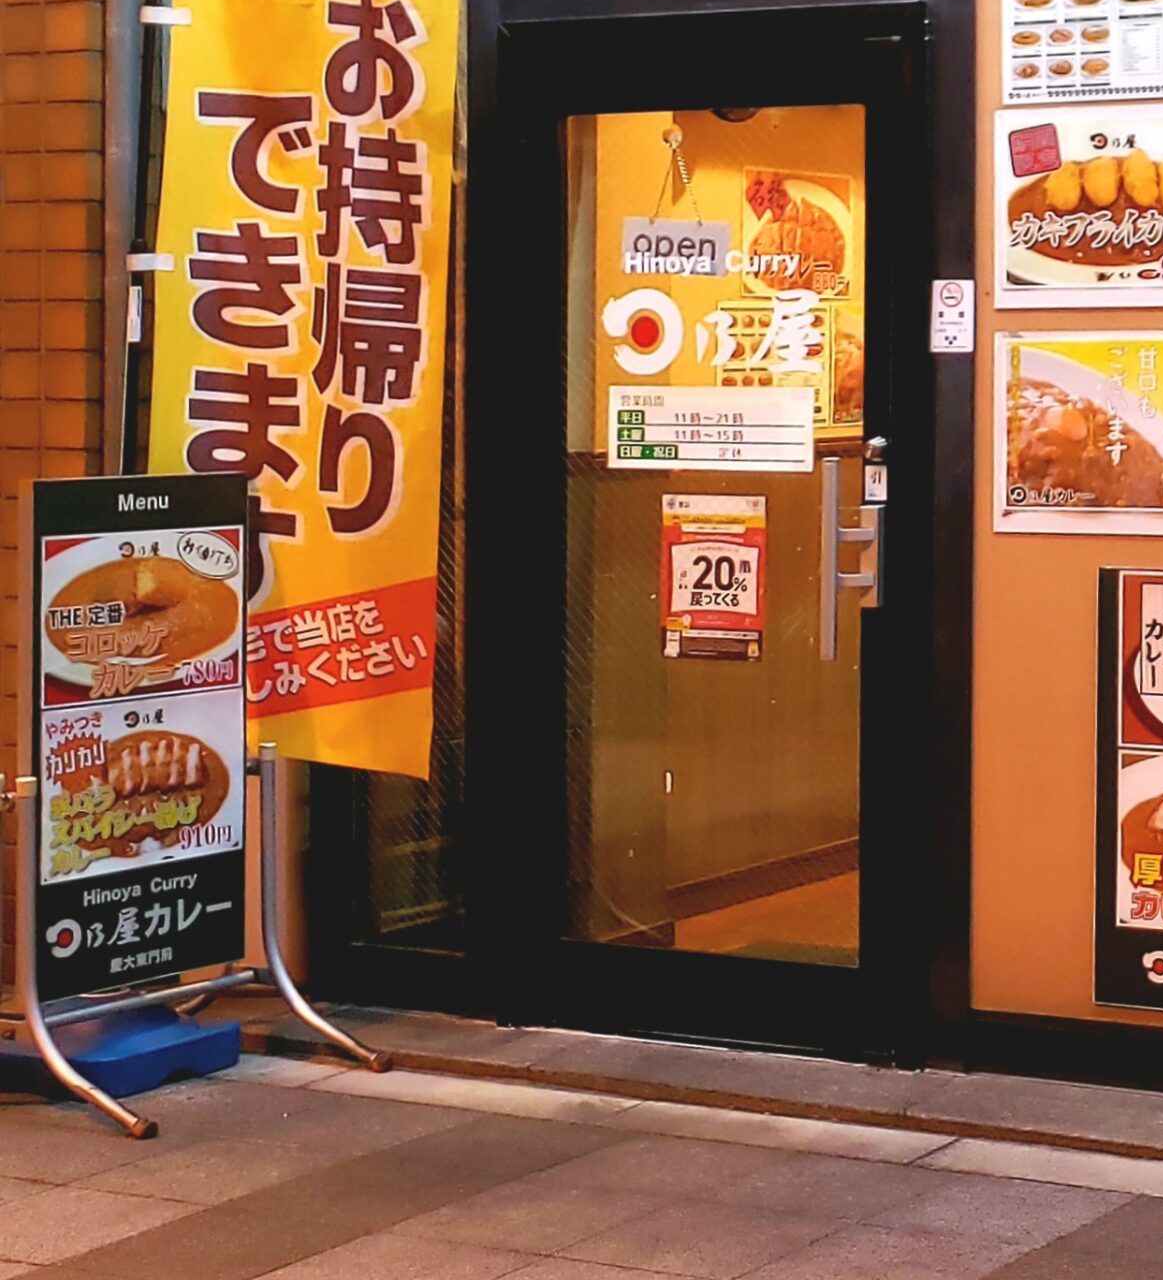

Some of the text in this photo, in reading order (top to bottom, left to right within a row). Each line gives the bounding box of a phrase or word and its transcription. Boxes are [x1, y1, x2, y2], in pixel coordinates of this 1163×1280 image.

[633, 233, 717, 260] open
[624, 251, 711, 276] Hinoya
[725, 250, 800, 276] Curry
[1137, 348, 1158, 419] 甘口も
[1105, 347, 1129, 466] ございます
[118, 493, 169, 511] Menu
[692, 555, 748, 592] 20%
[49, 601, 126, 628] THE 定番
[690, 591, 739, 607] 戻ってくる
[65, 623, 167, 663] コロッケ
[89, 663, 177, 699] カレー
[46, 711, 103, 739] やみつき
[50, 741, 106, 777] カリカリ
[179, 823, 233, 850] 910円
[83, 872, 198, 907] Hinoya Curry
